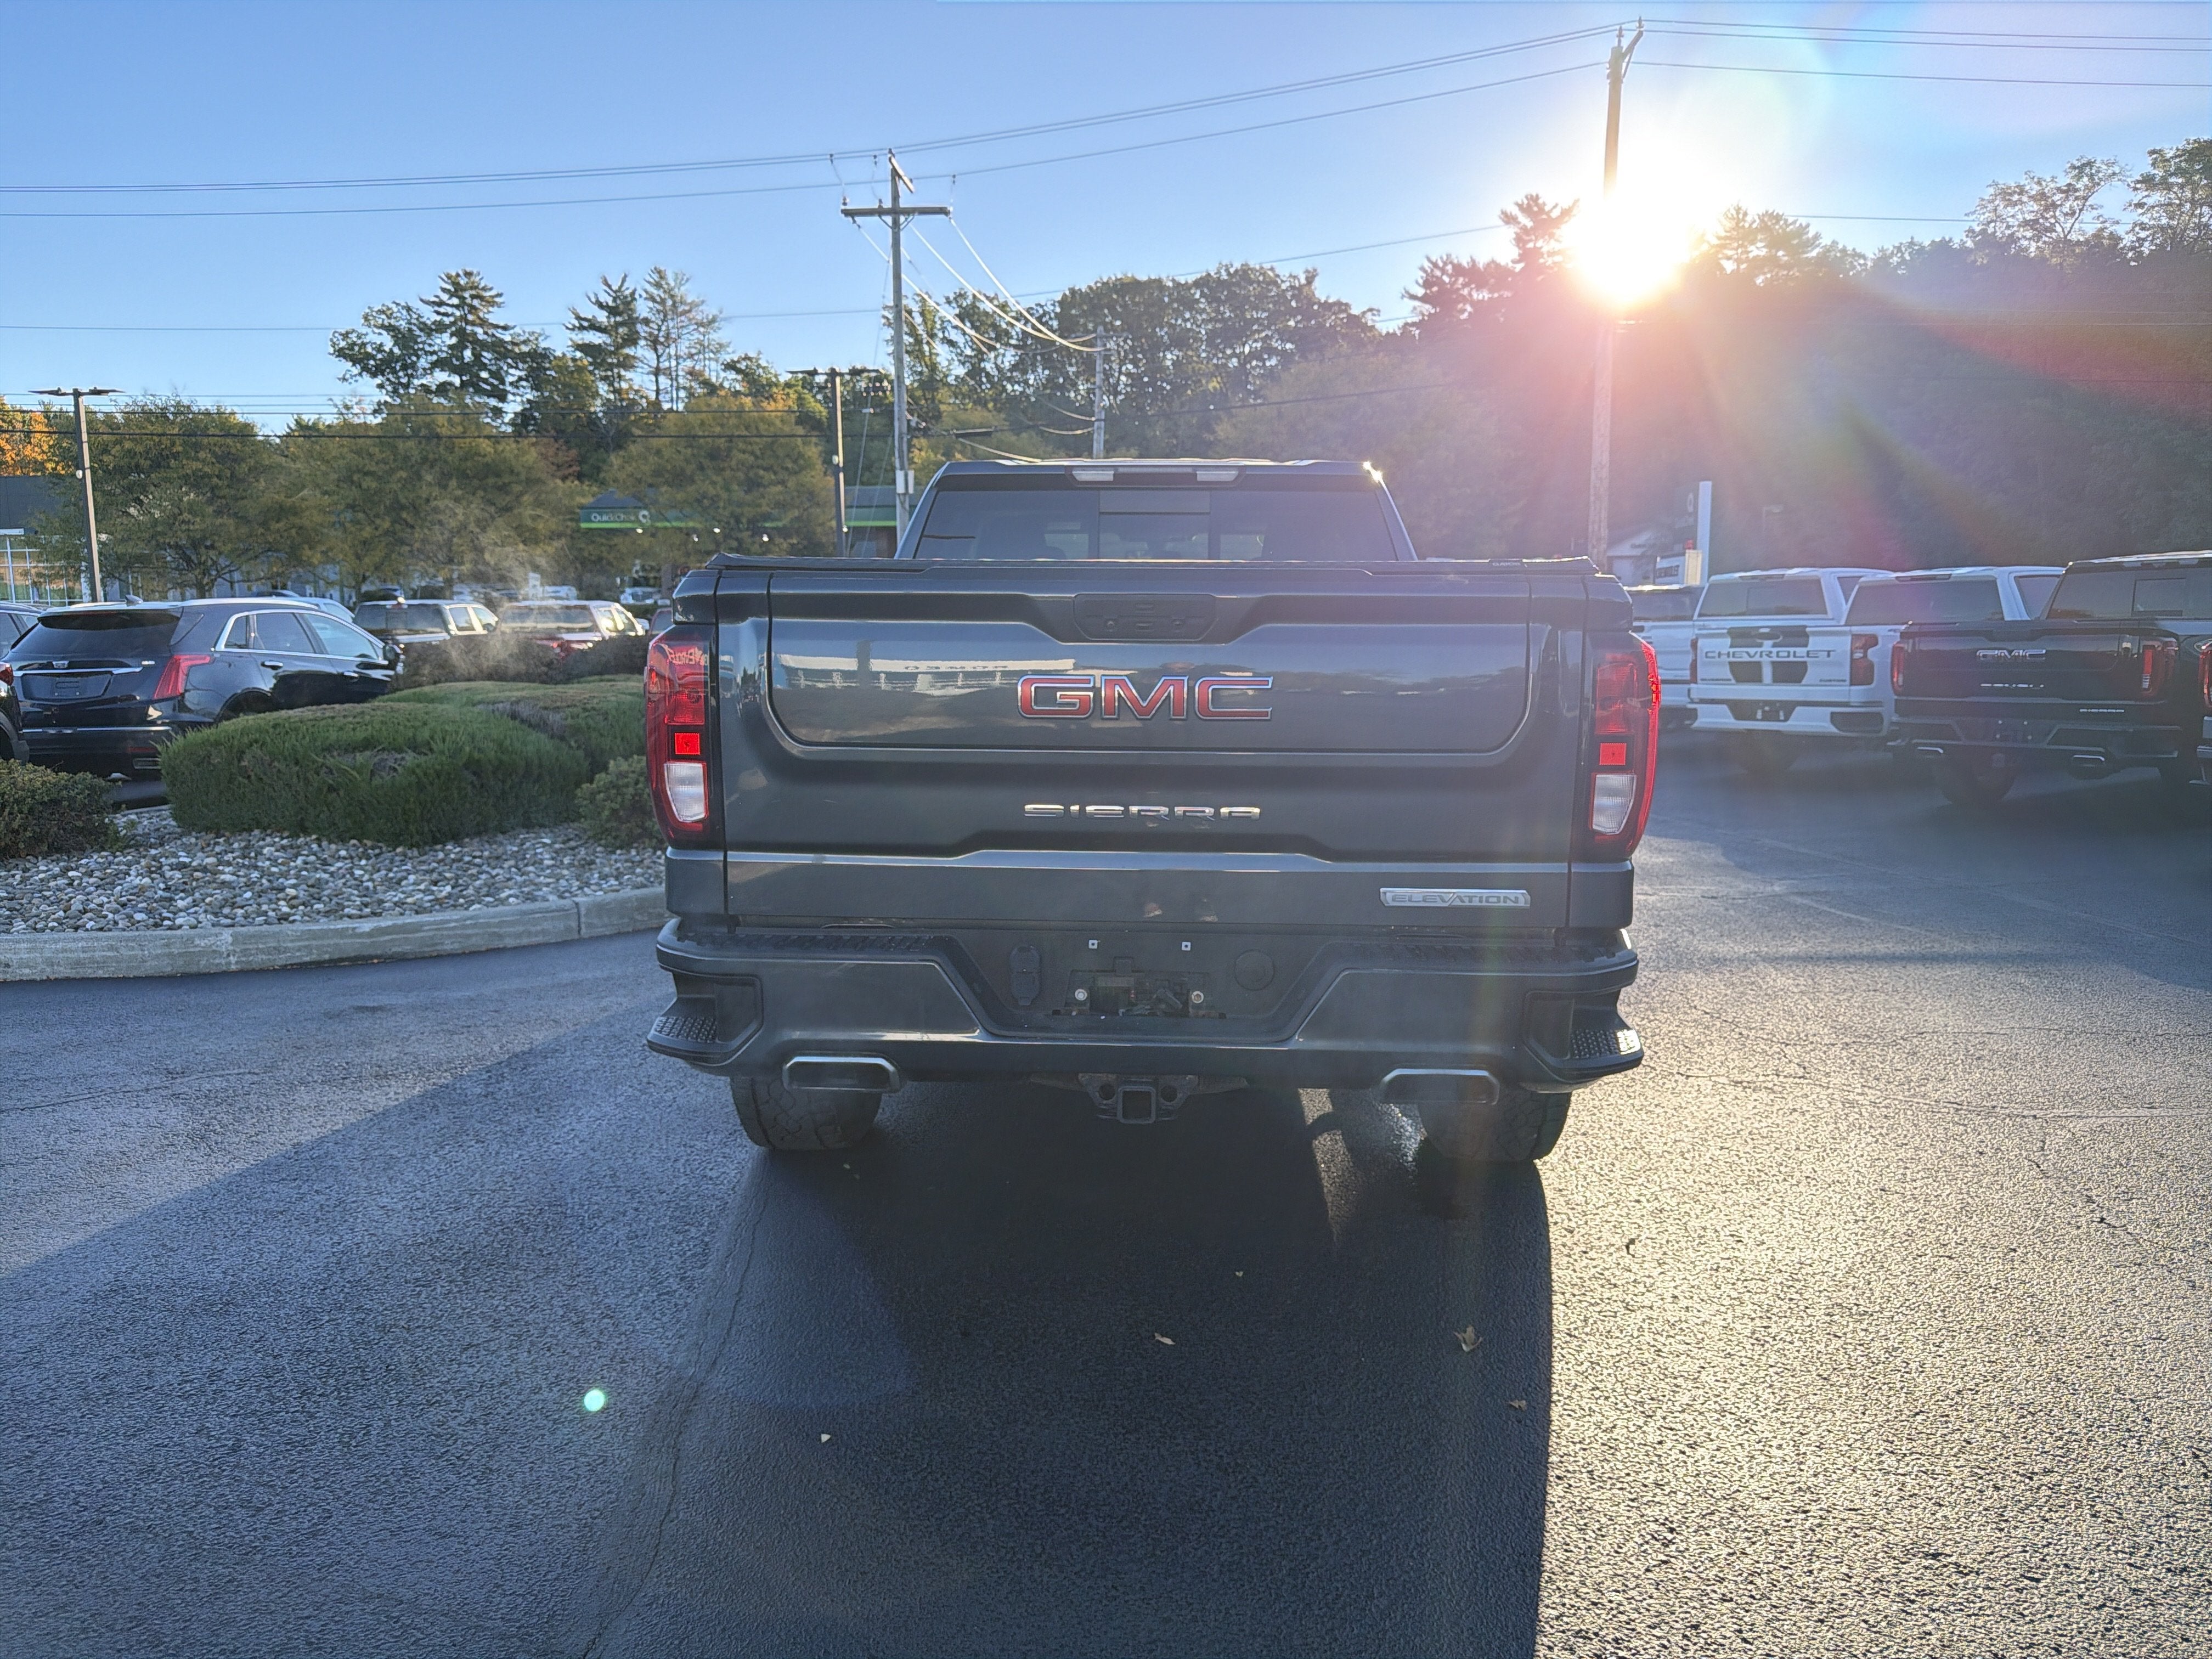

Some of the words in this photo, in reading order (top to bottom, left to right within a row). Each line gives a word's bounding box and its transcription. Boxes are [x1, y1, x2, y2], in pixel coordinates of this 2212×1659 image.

[1705, 650, 1836, 659] CHEVROLET
[1017, 674, 1273, 720] GMC
[1024, 805, 1261, 821] SIERRA
[1392, 894, 1519, 905] ELEVATION
